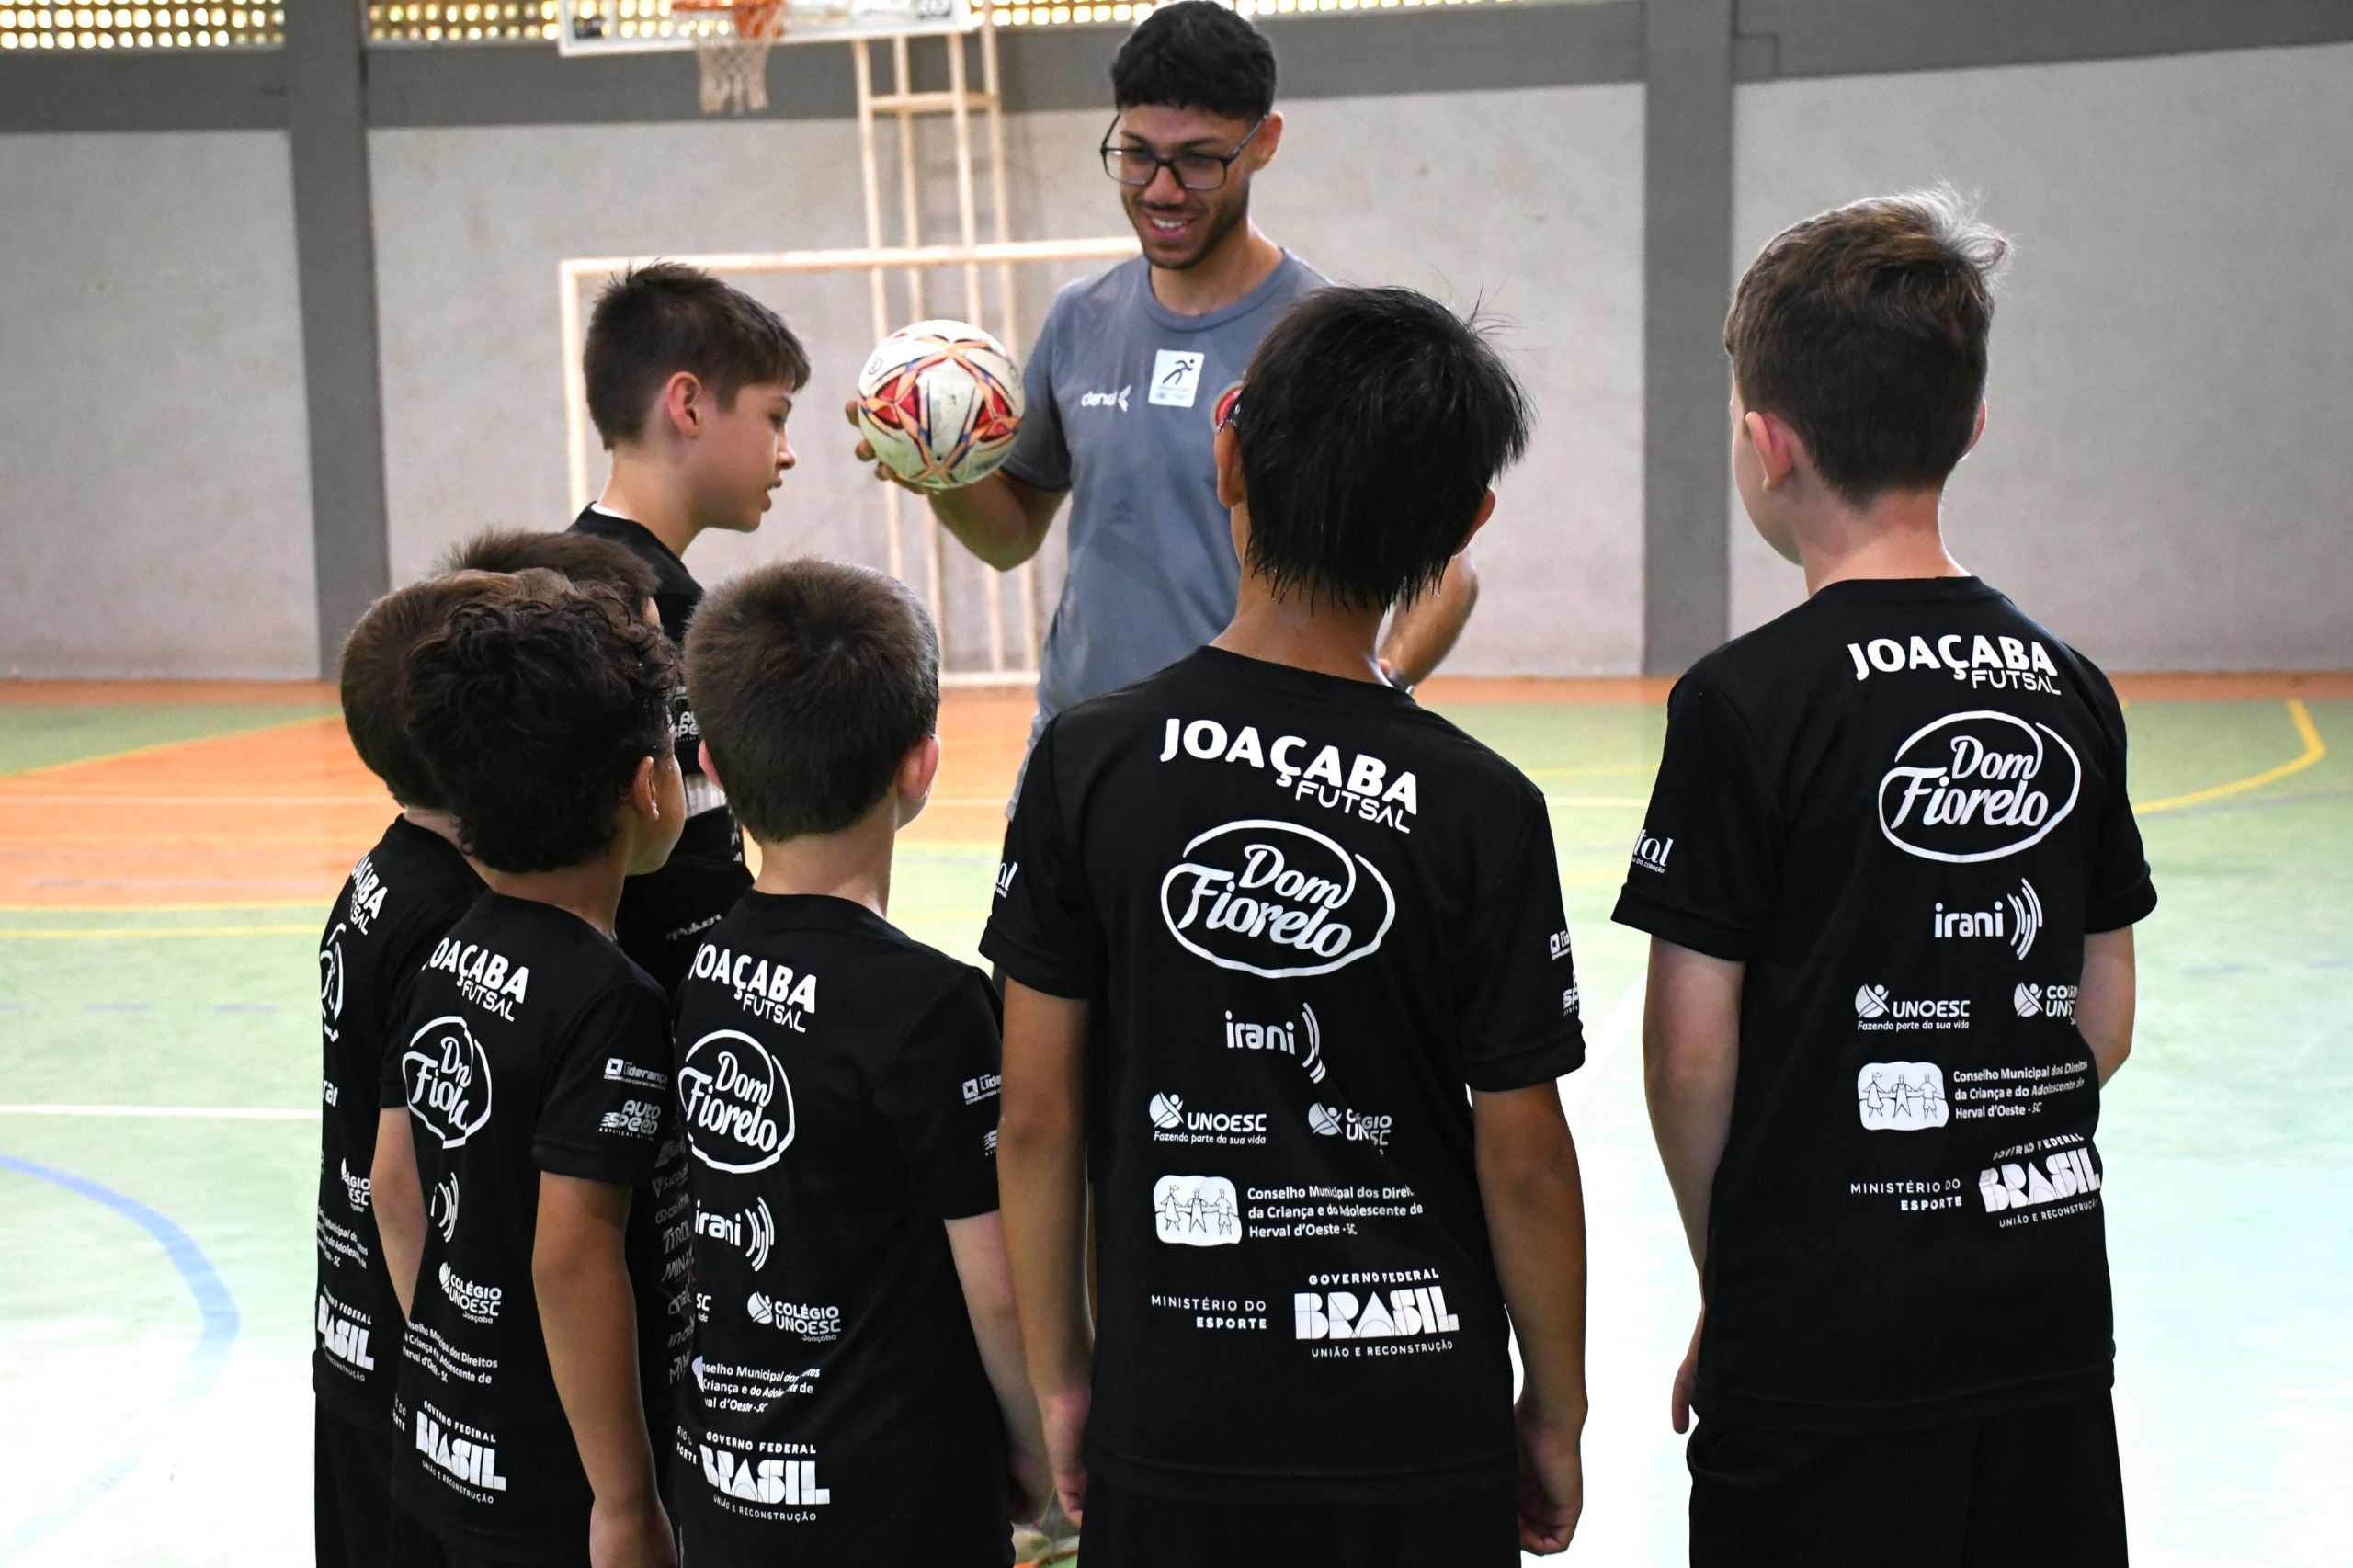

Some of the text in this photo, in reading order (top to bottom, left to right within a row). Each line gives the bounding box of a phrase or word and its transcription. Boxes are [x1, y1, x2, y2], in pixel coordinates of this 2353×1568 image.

[1847, 634, 2058, 681] JOAÇABA
[1971, 669, 2062, 695] FUTSAL
[1160, 718, 1417, 815] JOAÇABA
[1950, 735, 2035, 780] Dom
[1295, 780, 1411, 834] FUTSAL
[1882, 767, 2049, 829] Fiorelo
[1238, 844, 1343, 909] Dom
[1165, 862, 1352, 957] Fiorelo
[1934, 901, 2004, 938] irani
[421, 937, 529, 1004] OAÇABA
[461, 980, 515, 1022] FUTSAL
[743, 993, 806, 1033] FUTSAL
[1893, 1000, 1971, 1017] UNOESC
[1225, 1010, 1296, 1055] irani
[1858, 1020, 1969, 1032] Fazendo parte da sua vida
[715, 1051, 768, 1107] Dom
[1953, 1068, 1999, 1083] Conselho
[2000, 1065, 2050, 1080] Municipal
[2051, 1064, 2063, 1076] dos
[1955, 1088, 1967, 1101] da
[1970, 1087, 2005, 1100] Criança
[2006, 1088, 2013, 1098] e
[2015, 1085, 2029, 1097] do
[680, 1067, 778, 1153] Fiorelo
[1188, 1113, 1267, 1132] UNOESC
[1955, 1105, 1986, 1119] Herval
[2032, 1102, 2043, 1114] SC
[1154, 1131, 1267, 1145] Fazendo parte da sua vida
[1247, 1186, 1306, 1200] Conselho
[1308, 1185, 1354, 1201] Municipal
[1357, 1185, 1380, 1199] dos
[1850, 1177, 1961, 1195] MINISTÉRIO DO
[1978, 1147, 2101, 1213] BRASIL
[1247, 1201, 1423, 1221] da Criança e do Adolescente de
[1901, 1196, 1962, 1211] ESPORTE
[695, 1199, 741, 1246] irani
[1249, 1223, 1290, 1238] Herval
[1999, 1214, 2029, 1228] UNIÃO
[2032, 1212, 2039, 1222] E
[450, 1274, 502, 1301] COLÉGIO
[1308, 1267, 1439, 1286] GOVERNO FEDERAL
[449, 1286, 502, 1317] UNOESC
[775, 1301, 839, 1321] COLÉGIO
[1151, 1295, 1267, 1312] MINISTÉRIO DO
[1294, 1285, 1460, 1340] BRASIL
[775, 1315, 841, 1335] UNOESC
[1196, 1316, 1267, 1330] ESPORTE
[801, 1333, 837, 1343] Joaçaba
[1311, 1338, 1453, 1358] UNIÃO E RECONSTRUÇÃO
[409, 1335, 433, 1354] Criança
[478, 1372, 492, 1384] de
[461, 1352, 498, 1369] Direitos
[736, 1366, 785, 1383] Municipal
[741, 1385, 748, 1395] e
[750, 1384, 762, 1397] do
[800, 1381, 813, 1394] de
[424, 1400, 452, 1427] GOVERNO
[454, 1421, 496, 1444] FEDERAL
[416, 1410, 506, 1491] BRASIL
[706, 1430, 754, 1451] GOVERNO
[759, 1442, 817, 1454] FEDERAL
[699, 1444, 831, 1505] BRASIL
[442, 1473, 494, 1505] RECONSTRUÇÃO
[713, 1493, 817, 1524] UNIÃO E RECONSTRUÇÃO
